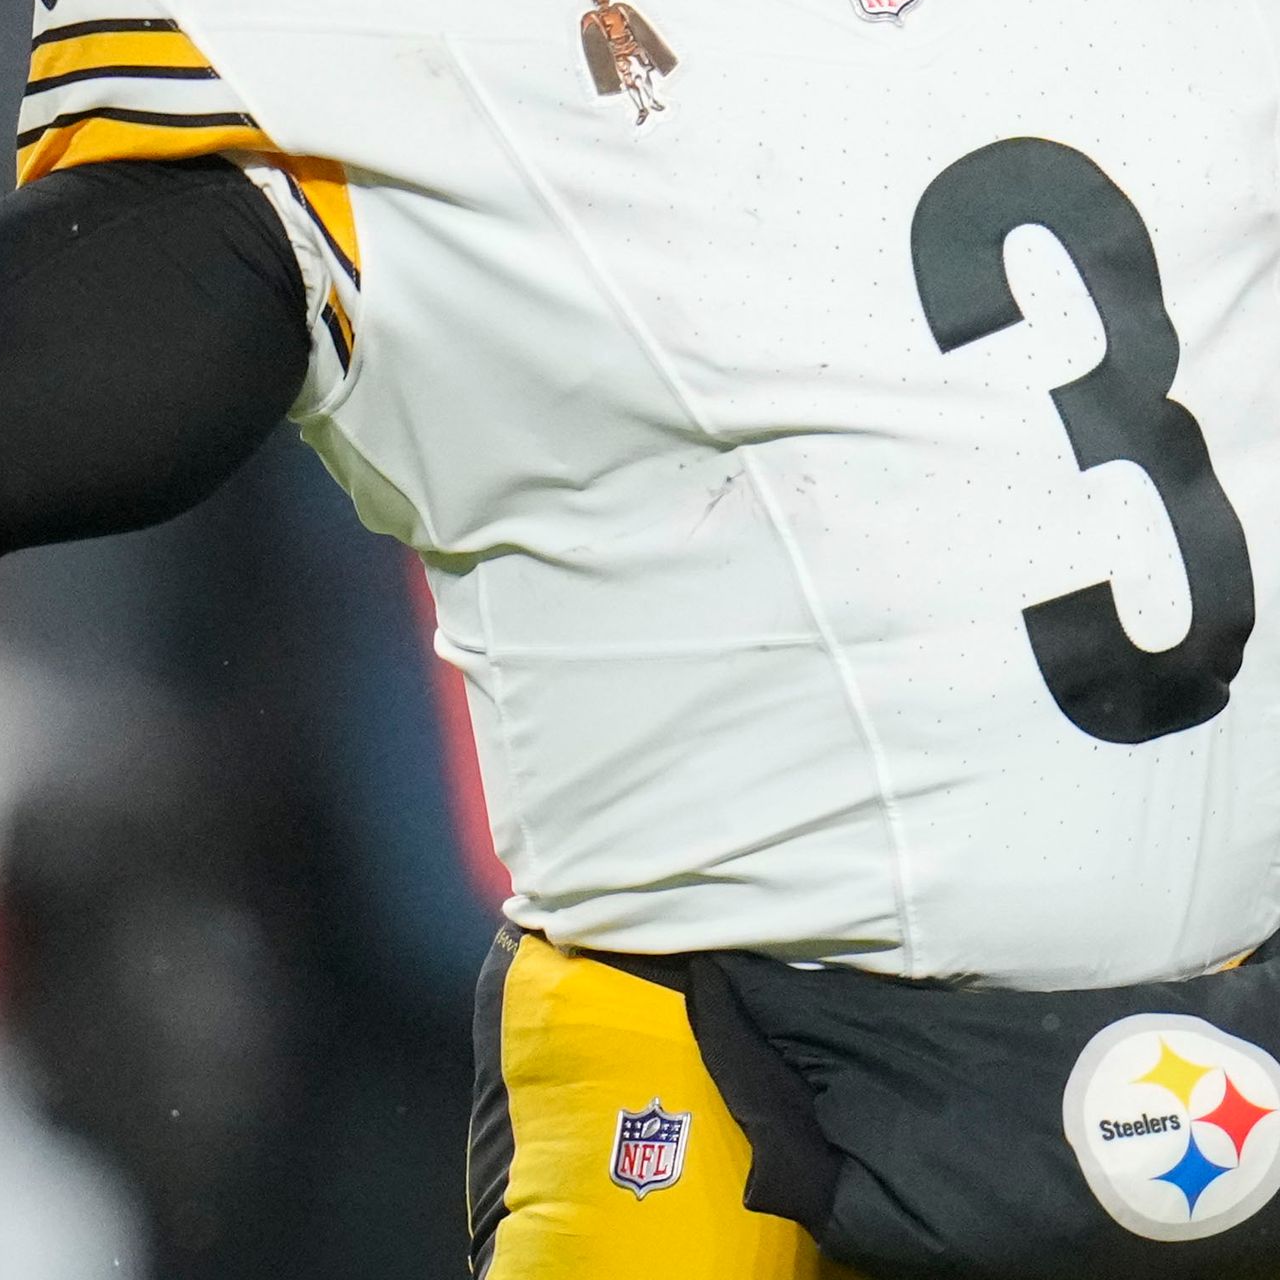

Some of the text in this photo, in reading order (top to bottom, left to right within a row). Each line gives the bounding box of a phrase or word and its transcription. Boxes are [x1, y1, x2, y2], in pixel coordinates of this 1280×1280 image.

[910, 136, 1256, 744] 3
[1099, 1112, 1182, 1141] Steelers
[620, 1142, 668, 1180] NFL
